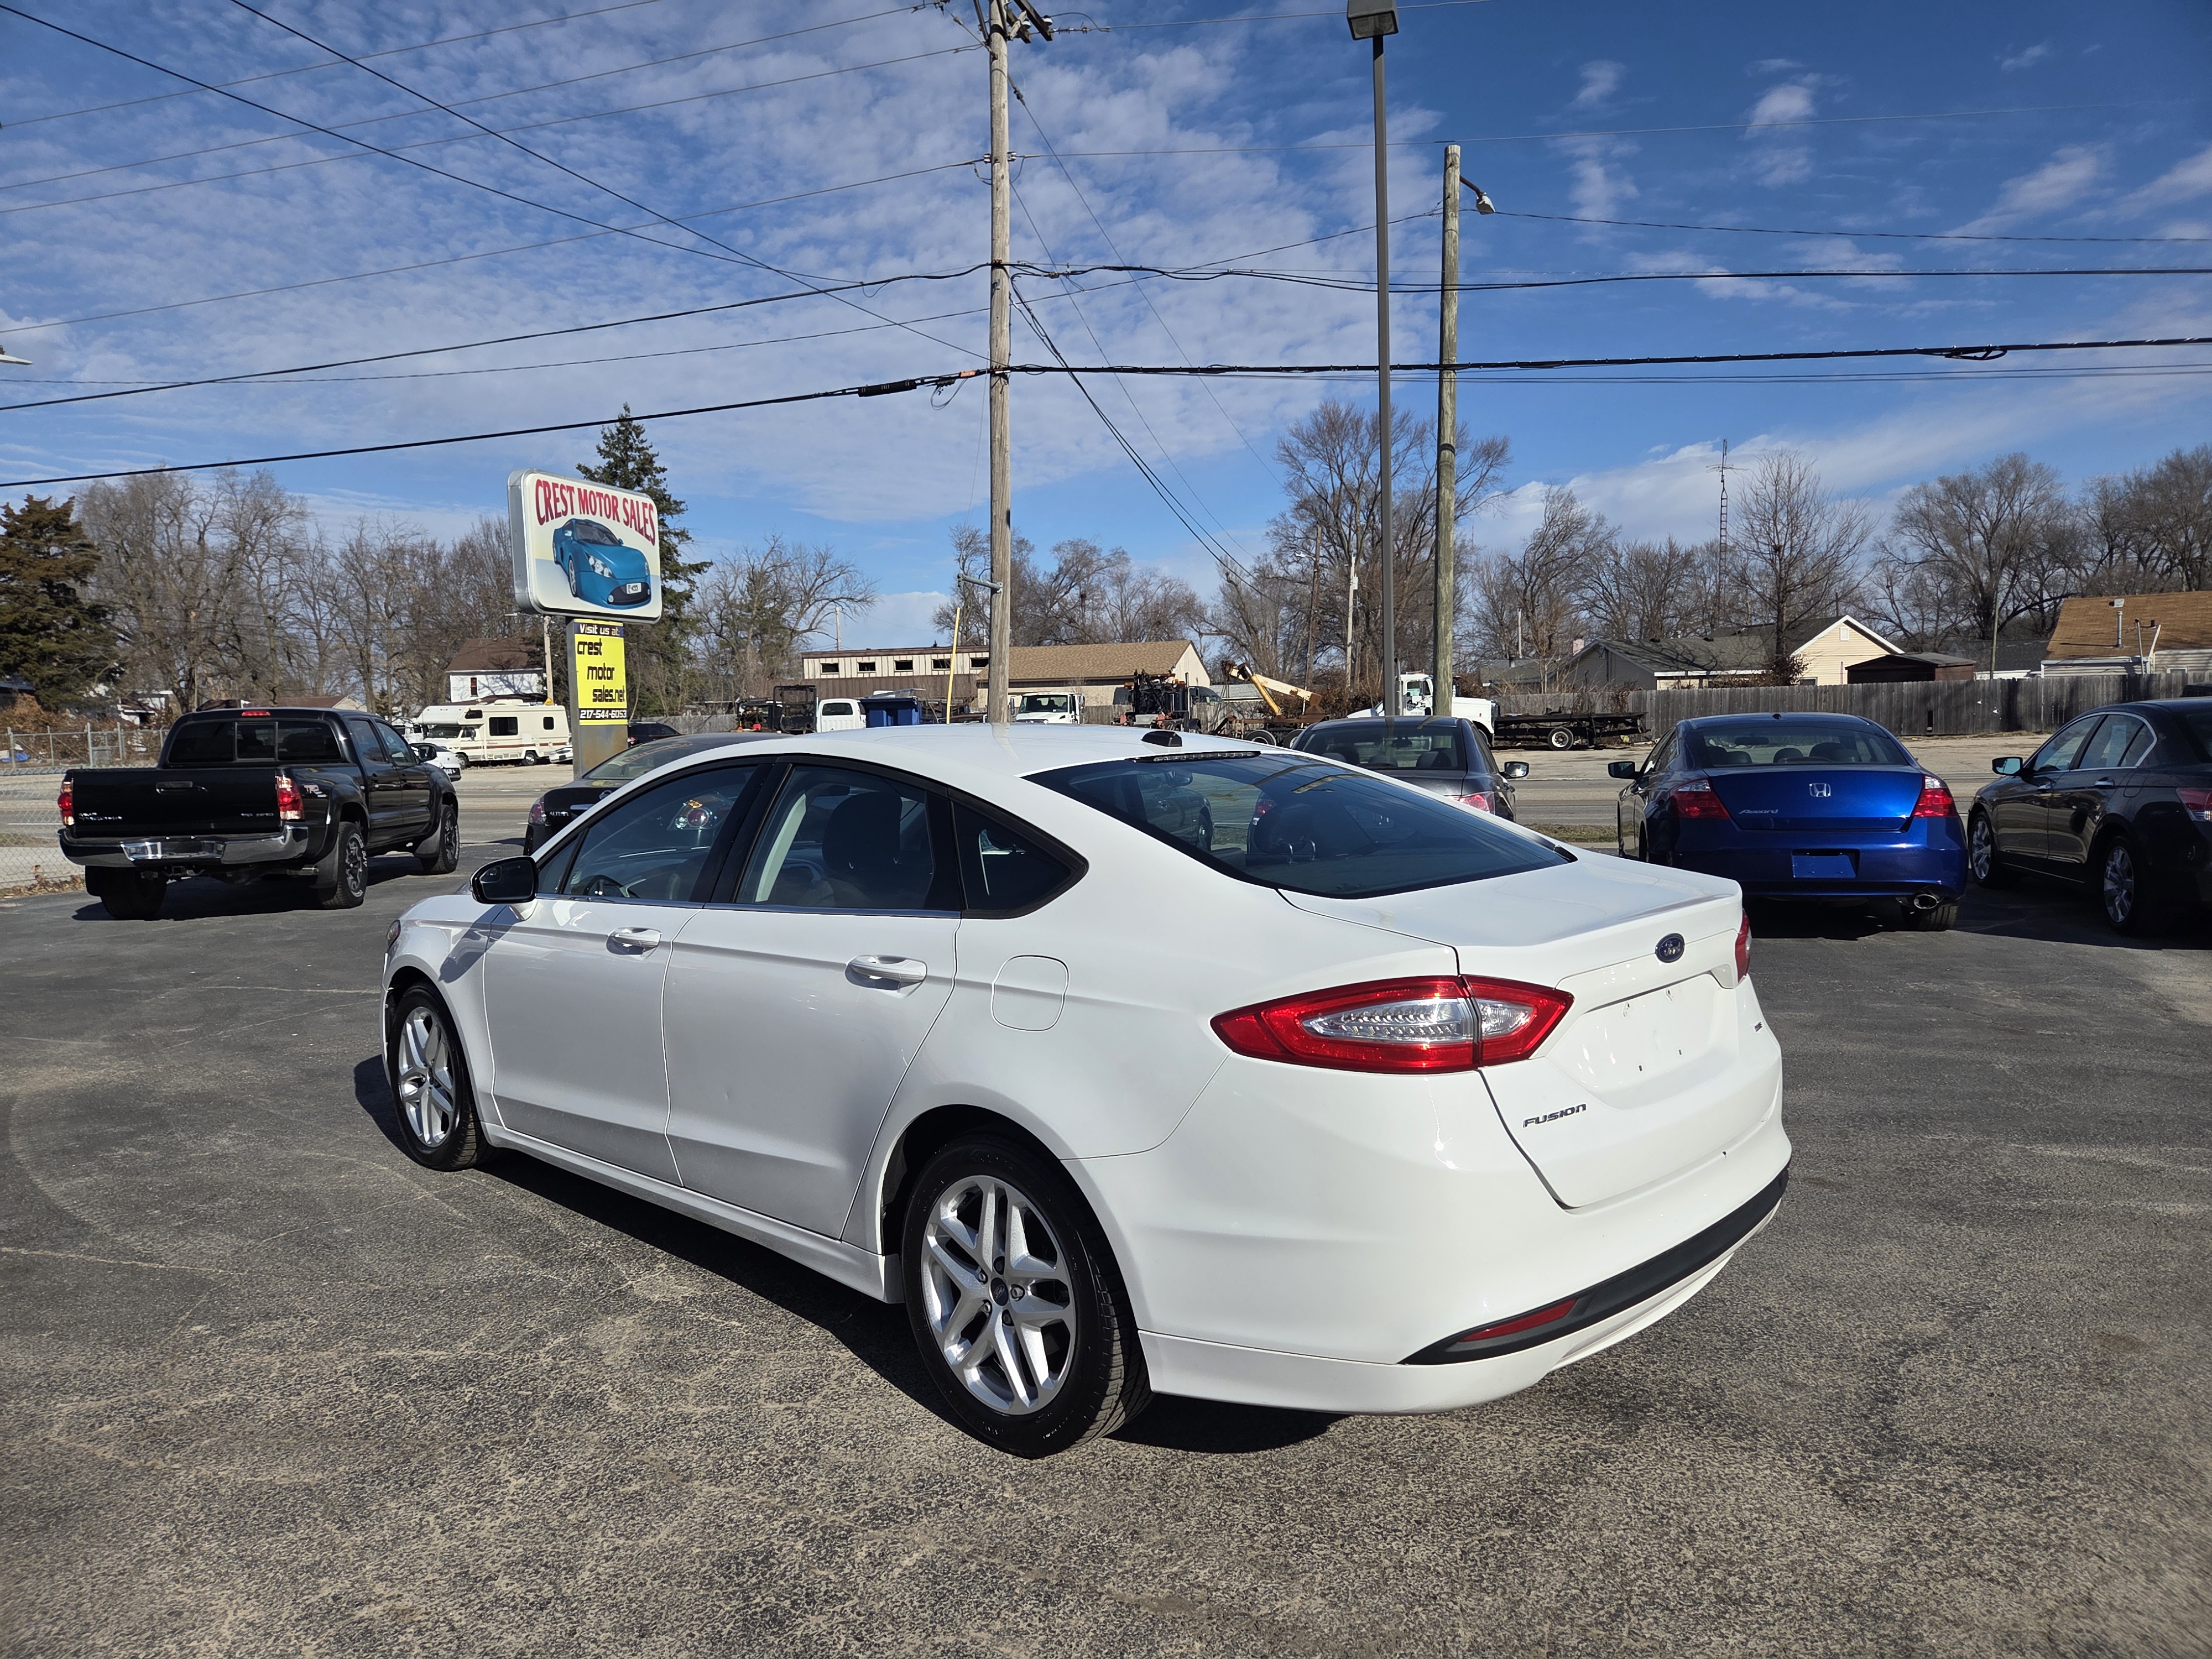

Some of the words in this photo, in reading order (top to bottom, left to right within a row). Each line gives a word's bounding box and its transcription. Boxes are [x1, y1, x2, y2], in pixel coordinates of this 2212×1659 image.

[535, 479, 575, 525] CREST
[577, 487, 620, 523] MOTOR
[623, 498, 655, 546] SALES
[580, 624, 598, 634] Visit
[612, 627, 620, 636] at:
[577, 638, 602, 655] crest
[587, 662, 615, 680] motor
[592, 685, 625, 702] sales.net
[580, 709, 627, 719] 217-544-6053
[1523, 1103, 1586, 1128] FUSION
